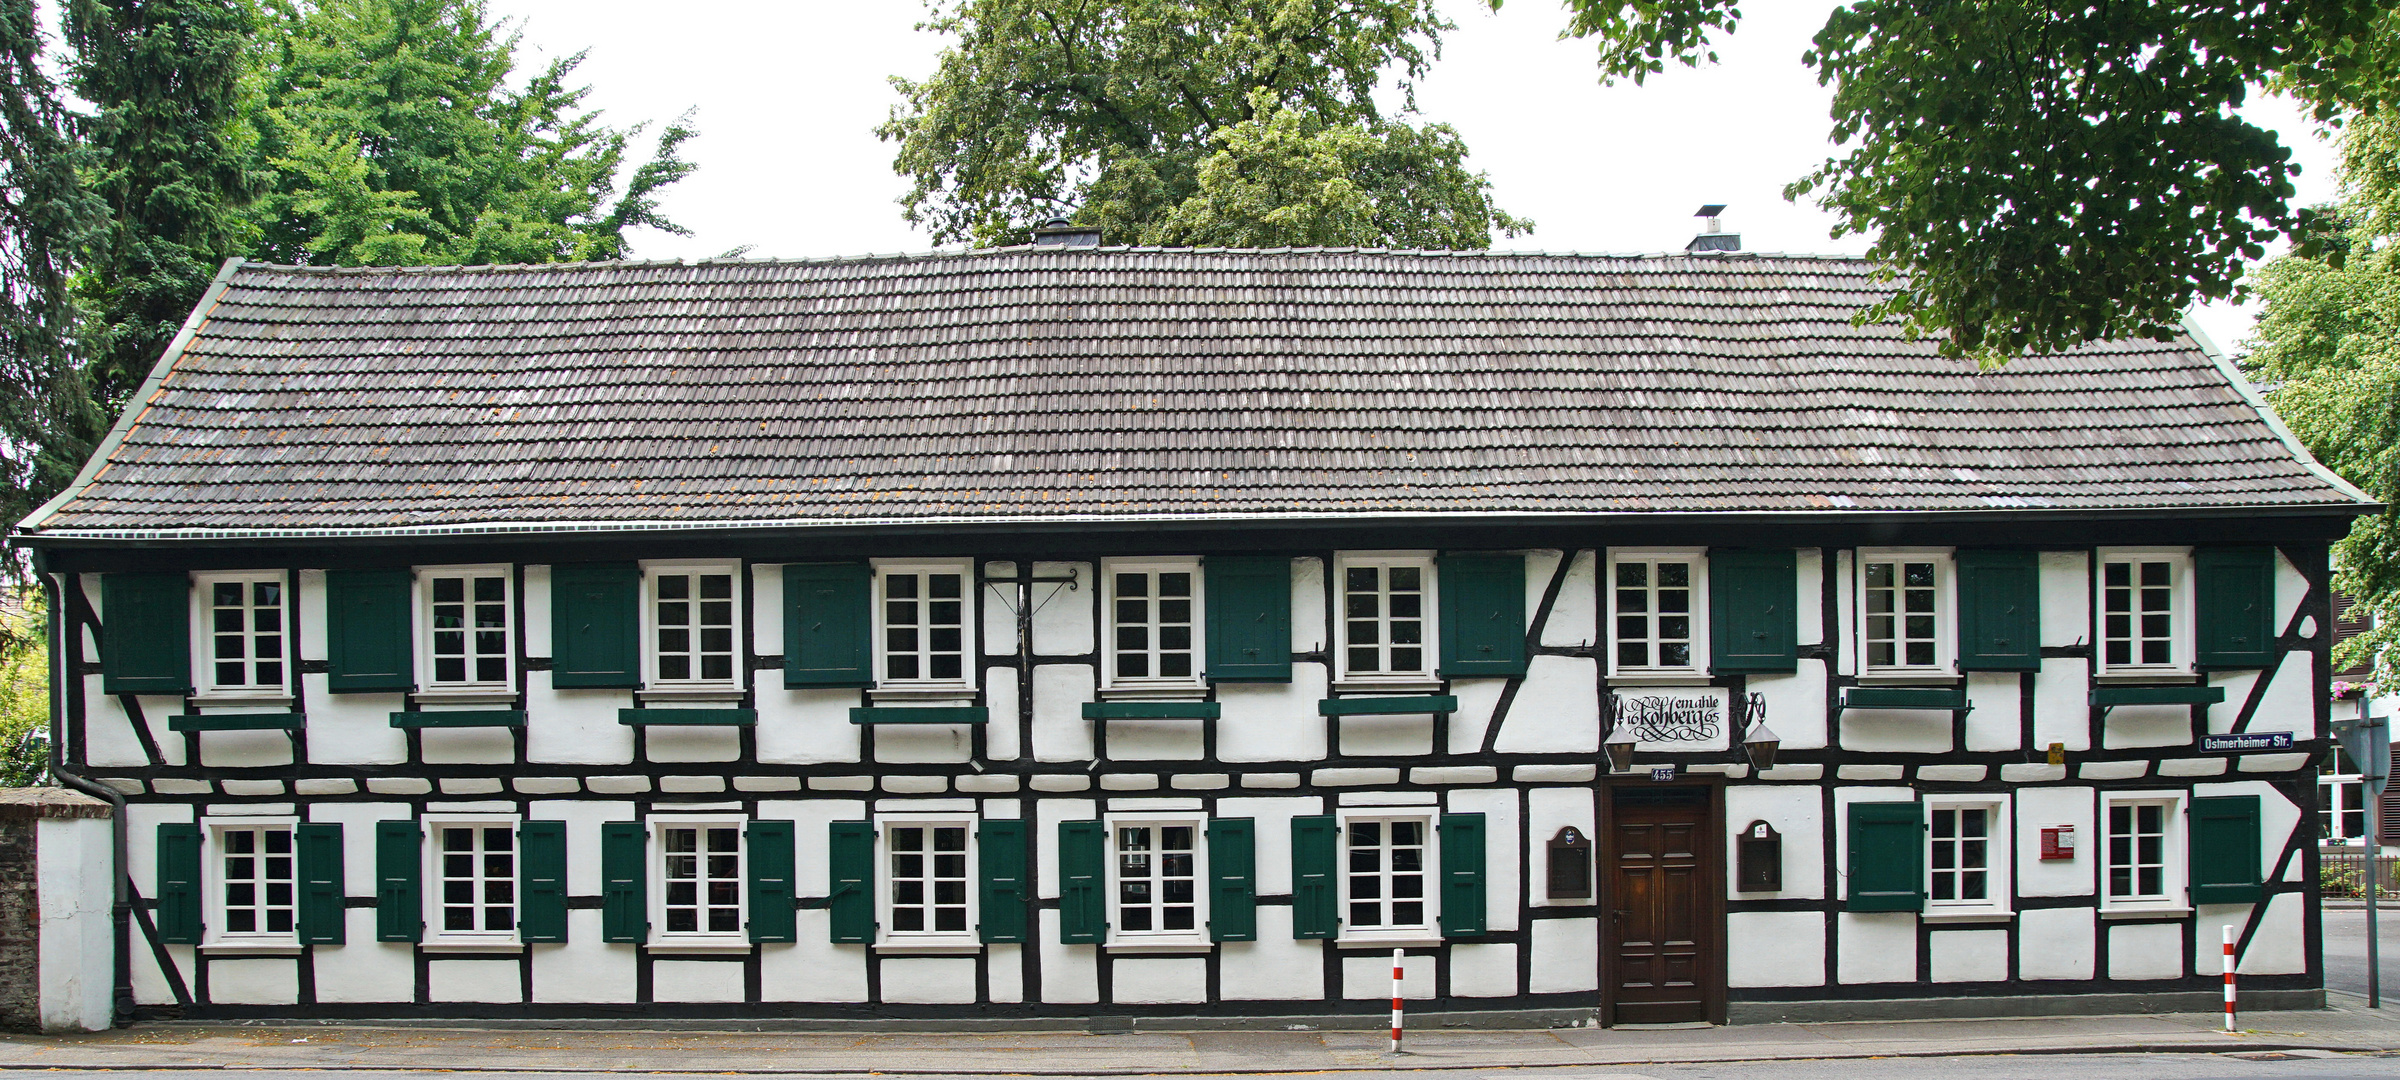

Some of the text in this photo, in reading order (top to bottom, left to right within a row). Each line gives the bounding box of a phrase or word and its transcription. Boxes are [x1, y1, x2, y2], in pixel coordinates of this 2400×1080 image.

[1627, 711, 1639, 725] 16
[1704, 708, 1720, 723] 65
[2204, 735, 2290, 750] Ostmerheimer Str.
[1653, 769, 1673, 780] 455
